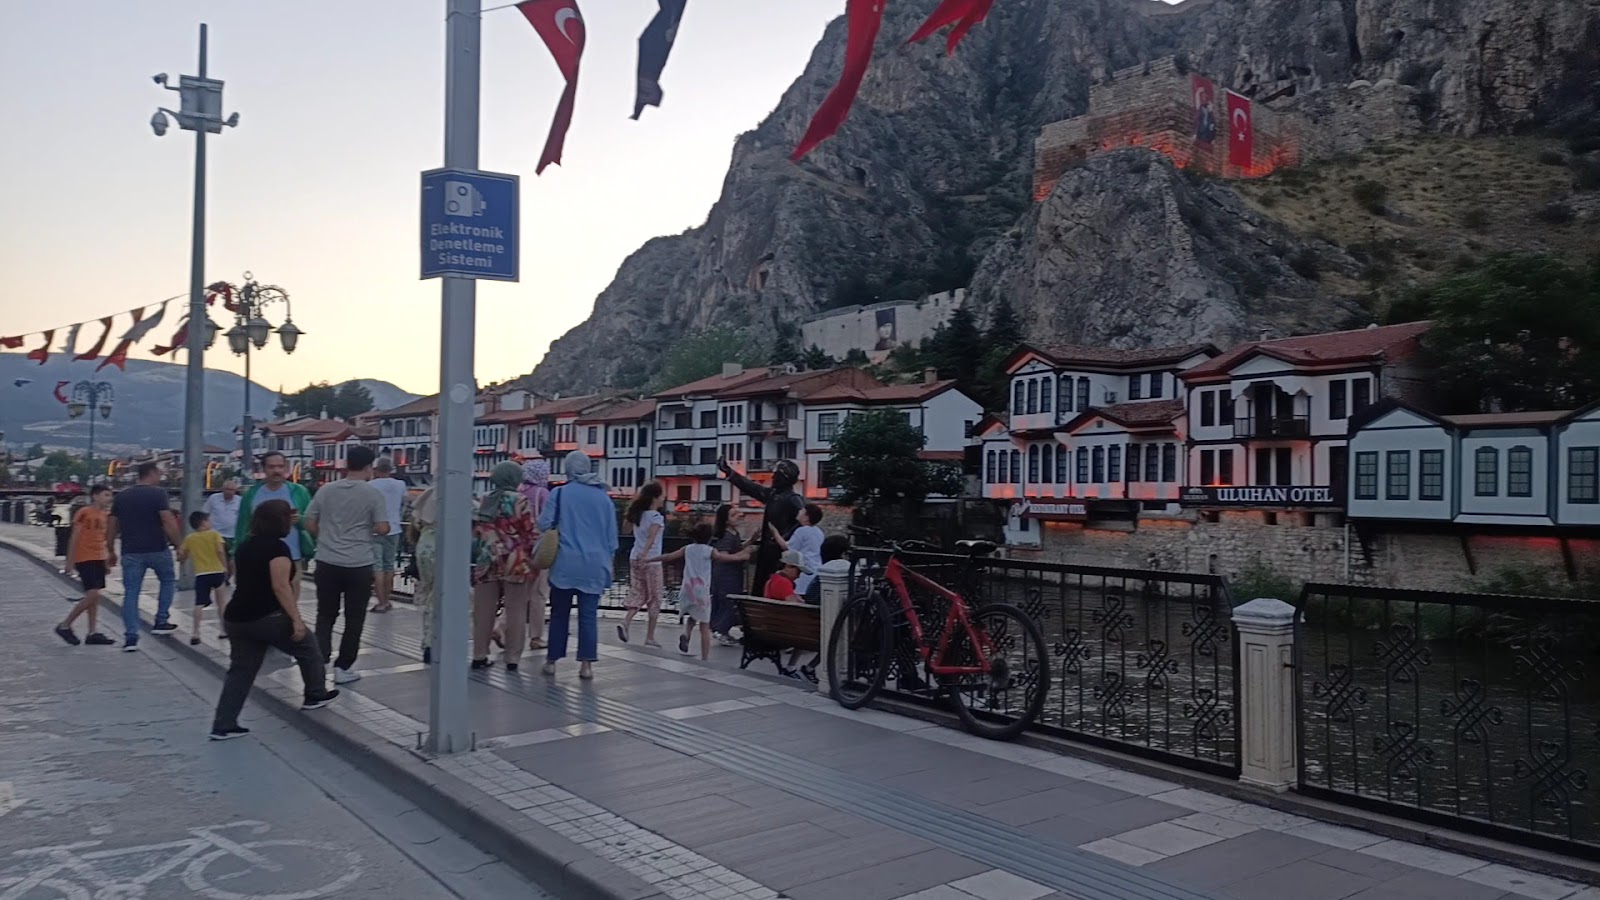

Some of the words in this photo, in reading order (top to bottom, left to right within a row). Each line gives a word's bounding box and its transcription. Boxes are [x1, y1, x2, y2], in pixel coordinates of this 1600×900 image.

[431, 222, 504, 239] Elektronik
[430, 239, 504, 254] Denetleme
[439, 252, 493, 267] Sistemi
[1217, 488, 1287, 501] ULUHAN
[1290, 488, 1334, 502] OTEL
